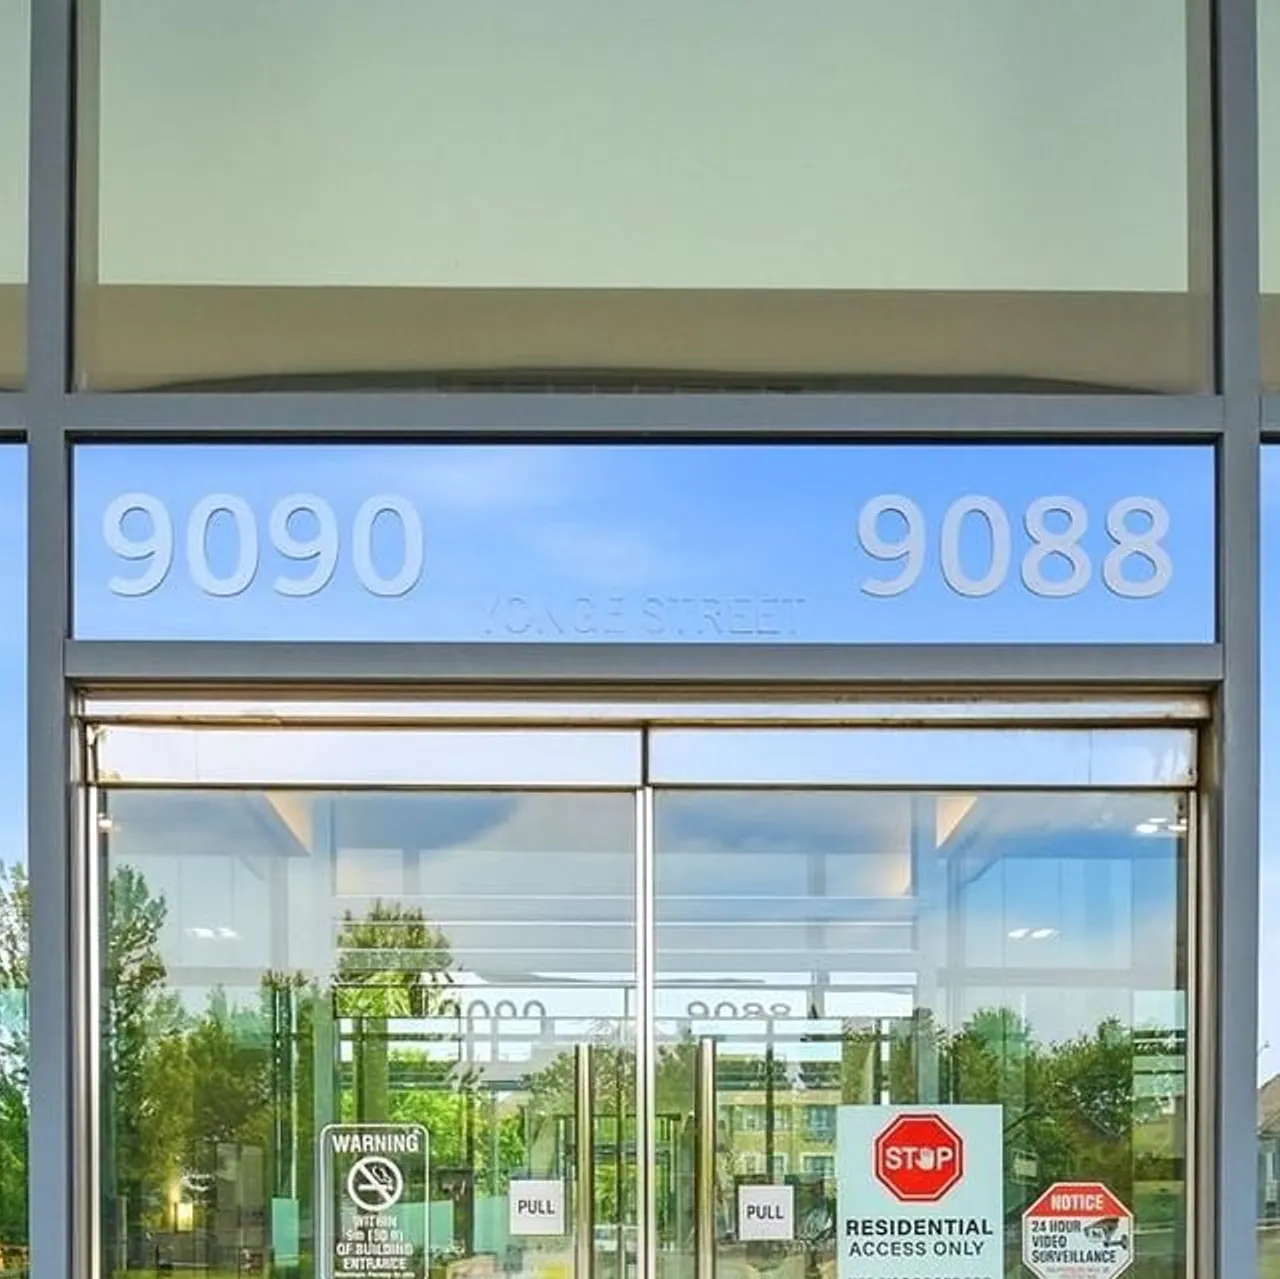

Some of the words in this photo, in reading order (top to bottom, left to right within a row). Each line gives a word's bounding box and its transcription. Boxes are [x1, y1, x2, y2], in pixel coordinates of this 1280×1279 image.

[102, 492, 425, 597] 9090
[858, 493, 1174, 598] 9088
[642, 597, 807, 634] STREET
[331, 1133, 419, 1153] WARNING
[885, 1146, 954, 1171] STOP
[517, 1199, 556, 1214] PULL
[1050, 1193, 1105, 1211] NOTICE
[746, 1204, 785, 1220] PULL
[845, 1219, 993, 1236] RESIDENTIAL
[1031, 1220, 1047, 1233] 24
[1049, 1220, 1081, 1233] HOUR
[336, 1243, 353, 1256] OF
[848, 1241, 928, 1257] ACCESS
[933, 1241, 985, 1256] ONLY
[1031, 1235, 1068, 1248] VIDEO
[343, 1257, 408, 1270] ENTRANCE
[1031, 1250, 1117, 1263] SURVEILLANCE
